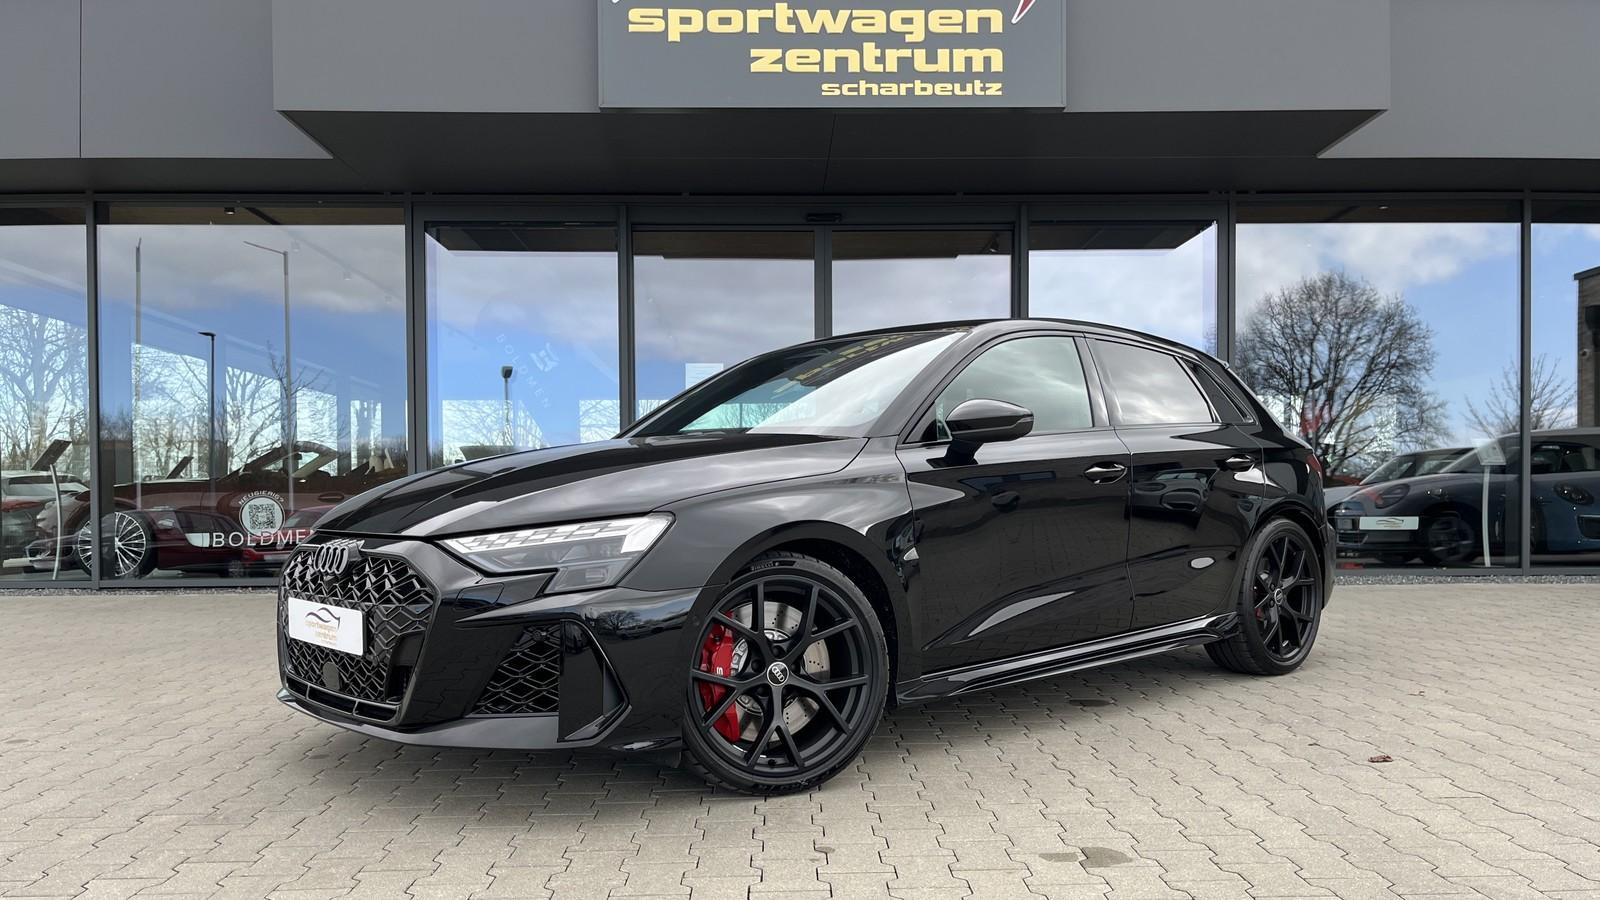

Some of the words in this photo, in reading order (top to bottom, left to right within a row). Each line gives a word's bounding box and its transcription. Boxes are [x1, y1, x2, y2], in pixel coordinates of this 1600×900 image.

[627, 2, 1004, 42] sportwagen
[749, 41, 1004, 73] zentrum
[821, 79, 1003, 96] scharbeutz
